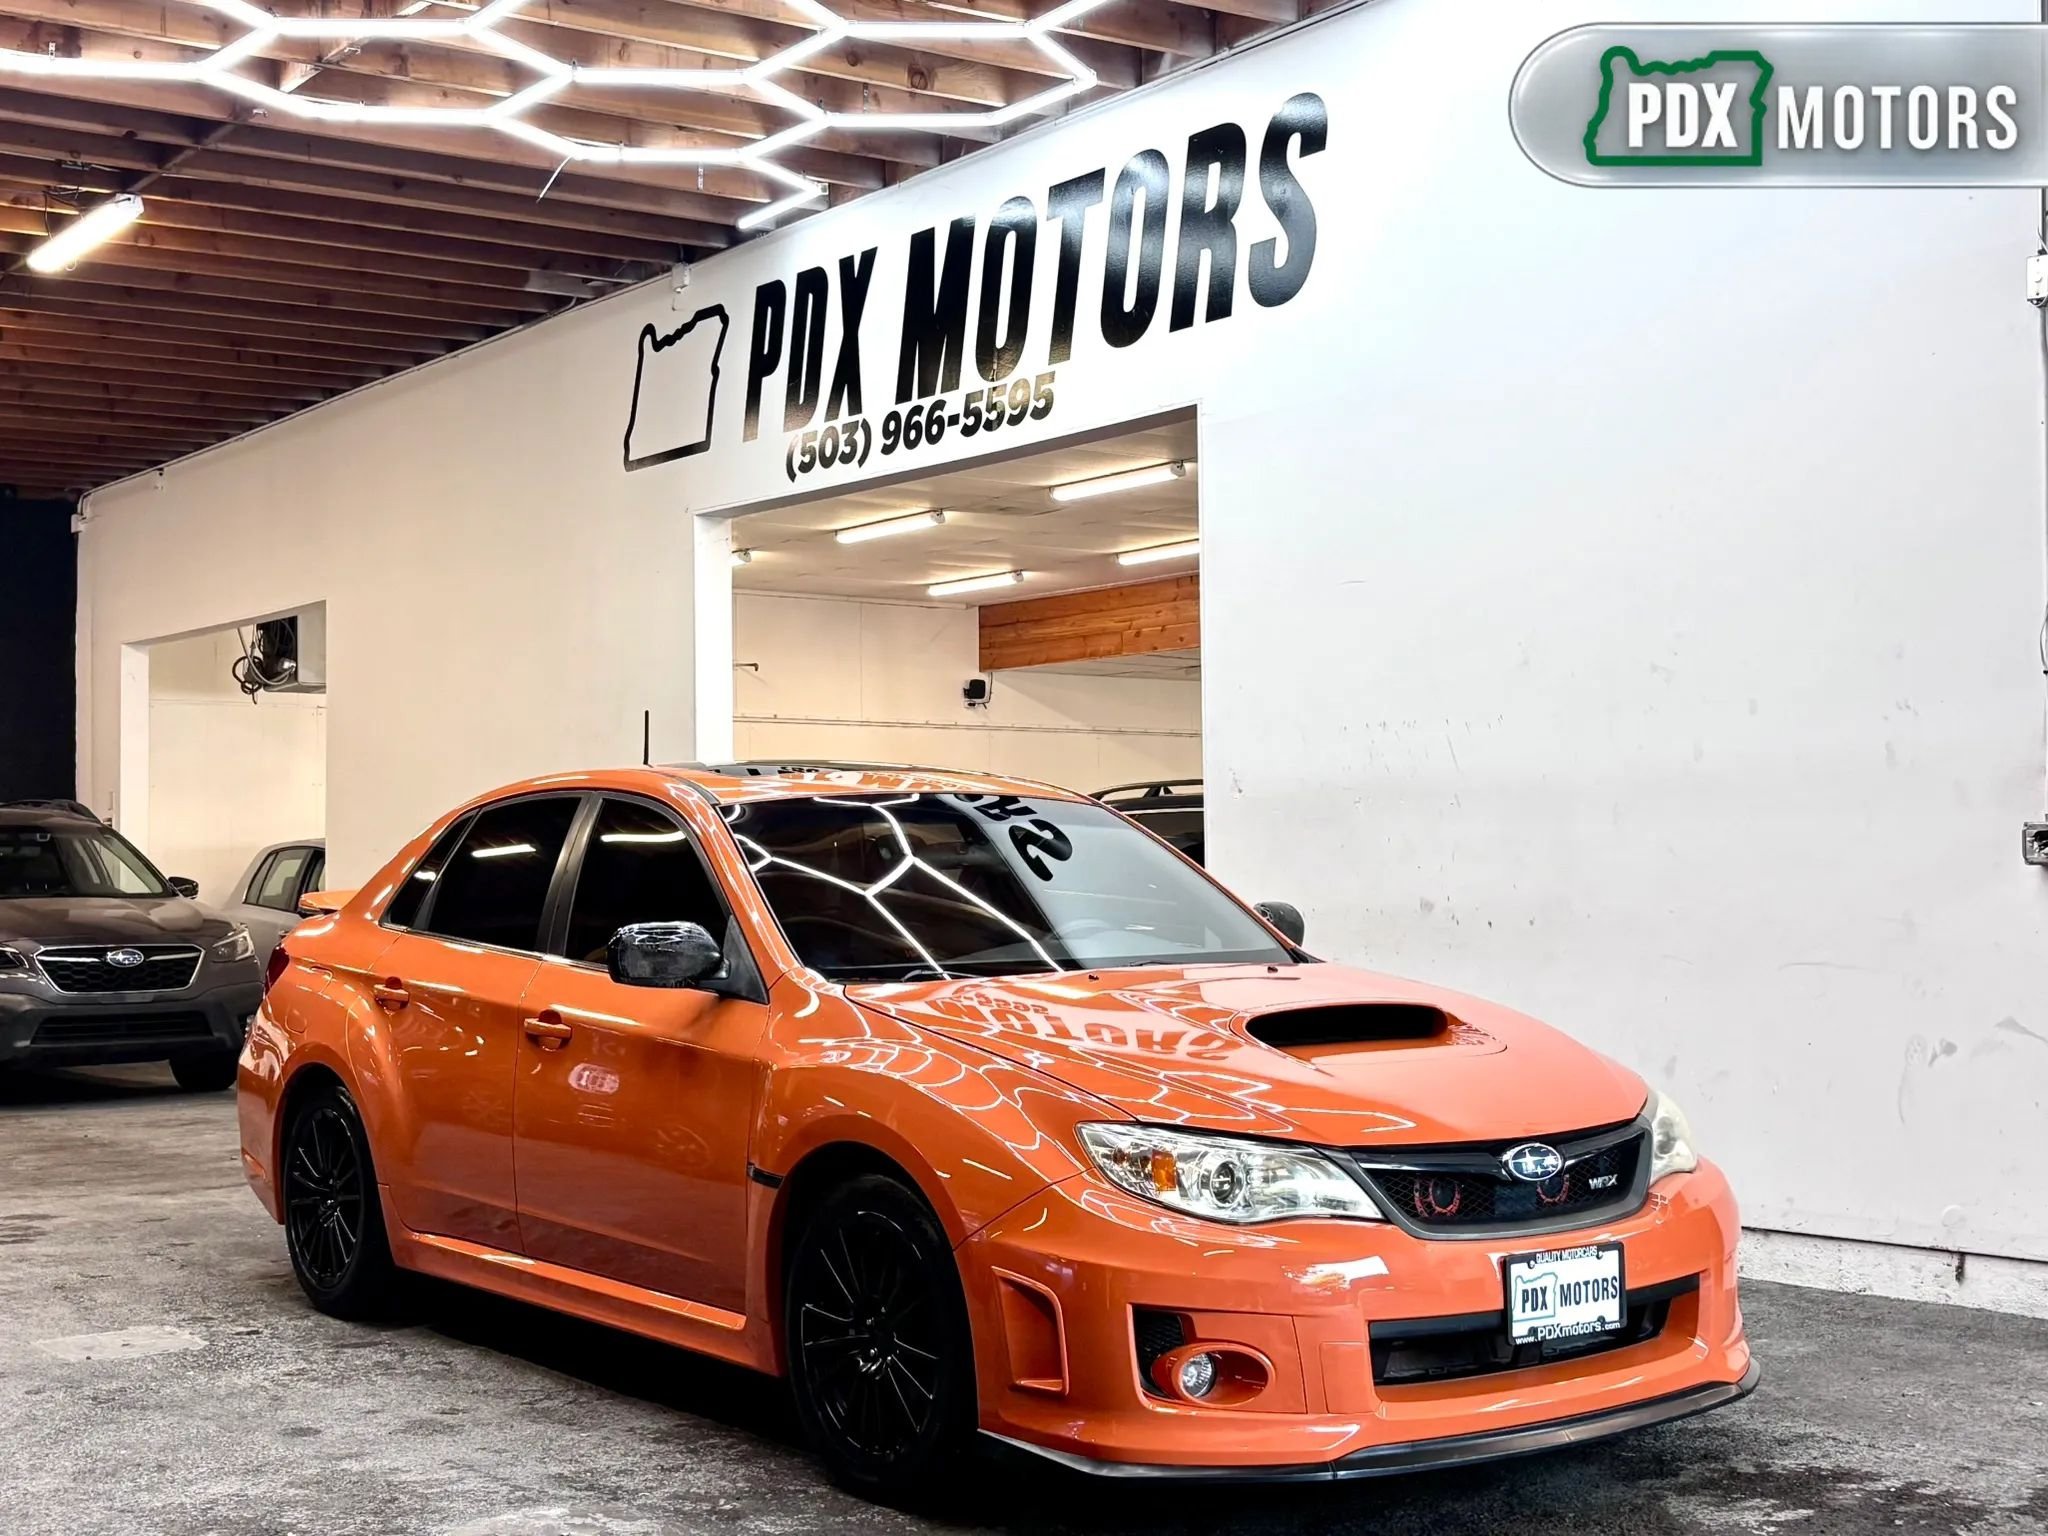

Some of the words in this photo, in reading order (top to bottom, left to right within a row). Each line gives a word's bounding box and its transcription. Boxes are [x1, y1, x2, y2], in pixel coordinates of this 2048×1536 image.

[743, 246, 878, 442] PDX
[895, 92, 1328, 405] MOTORS
[786, 418, 871, 482] (503)
[881, 371, 1056, 456] 966-5595
[1589, 1174, 1618, 1190] WRX
[1535, 1250, 1560, 1264] QUALITY
[1561, 1246, 1598, 1261] MOTORCARS
[1521, 1286, 1548, 1313] PDX
[1560, 1275, 1618, 1308] MOTORS
[1515, 1321, 1621, 1345] www.PDXmotors.com
